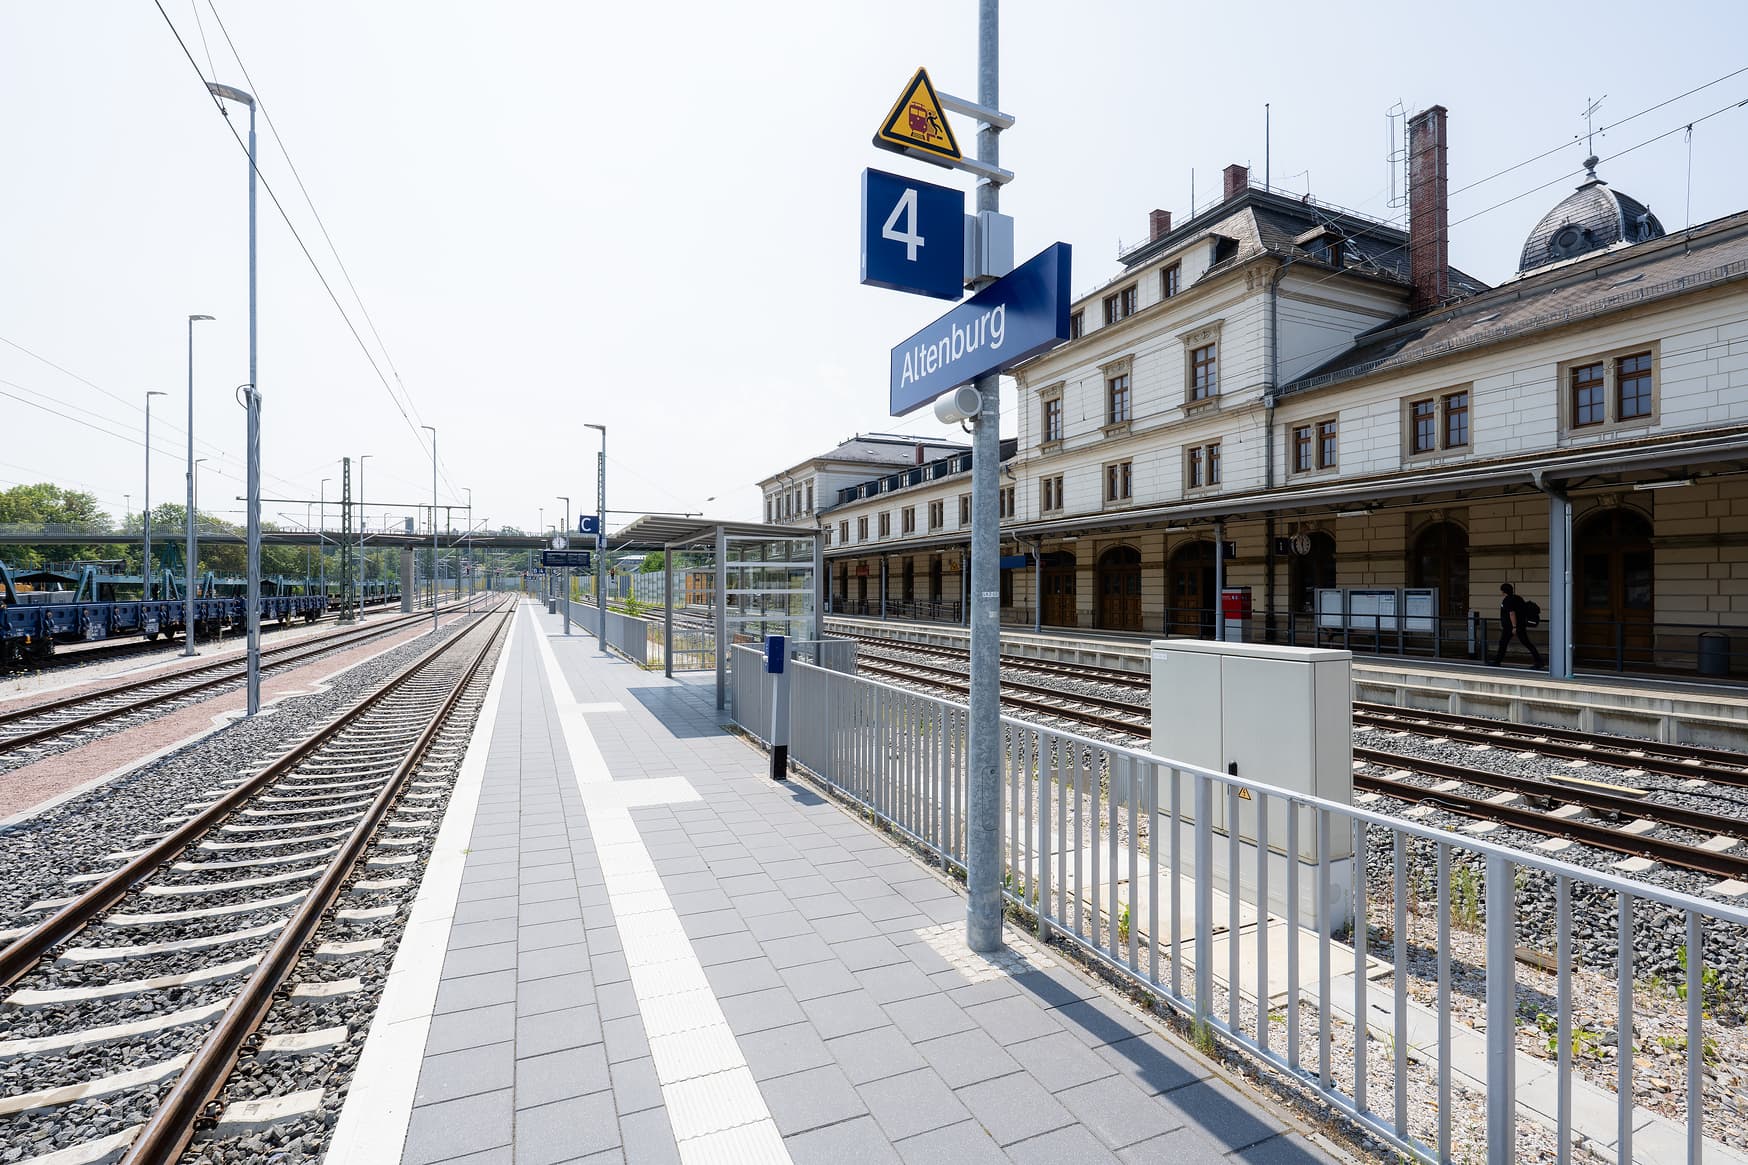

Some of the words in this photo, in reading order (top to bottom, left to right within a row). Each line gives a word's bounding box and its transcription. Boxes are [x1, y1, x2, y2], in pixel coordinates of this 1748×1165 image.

[882, 188, 925, 262] 4
[901, 303, 1006, 389] Altenburg
[582, 518, 591, 531] C
[1229, 542, 1235, 556] 1
